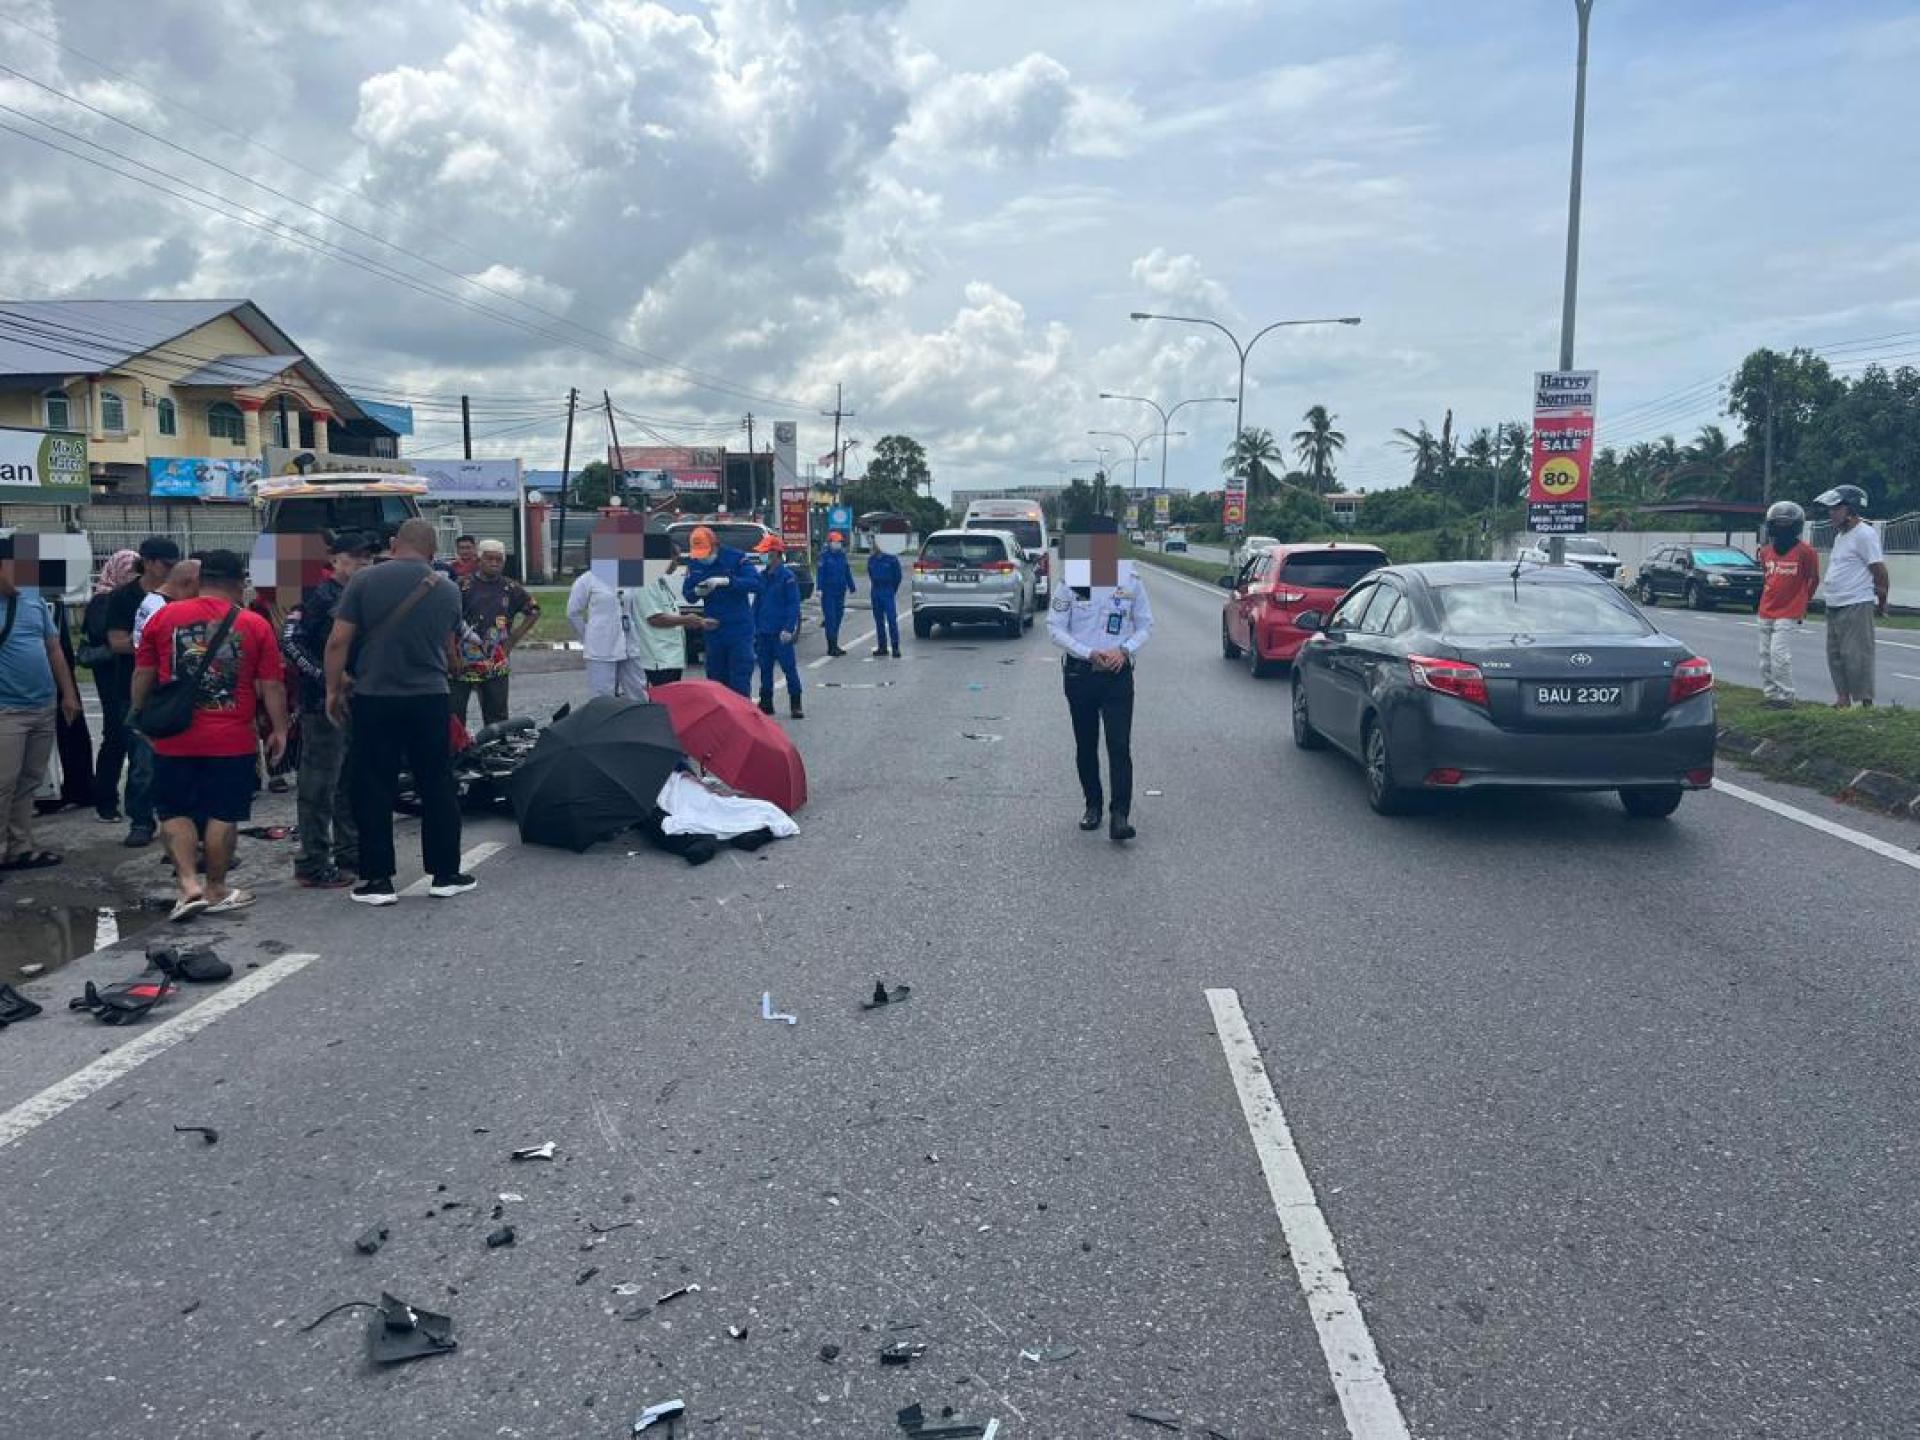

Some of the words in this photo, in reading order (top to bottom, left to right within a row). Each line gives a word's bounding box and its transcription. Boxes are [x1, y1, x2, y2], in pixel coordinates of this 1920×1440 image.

[1540, 374, 1590, 389] Harvey
[1536, 392, 1592, 406] Norman
[1541, 439, 1582, 451] SALE
[1538, 687, 1571, 703] BAU
[1577, 687, 1620, 703] 2307
